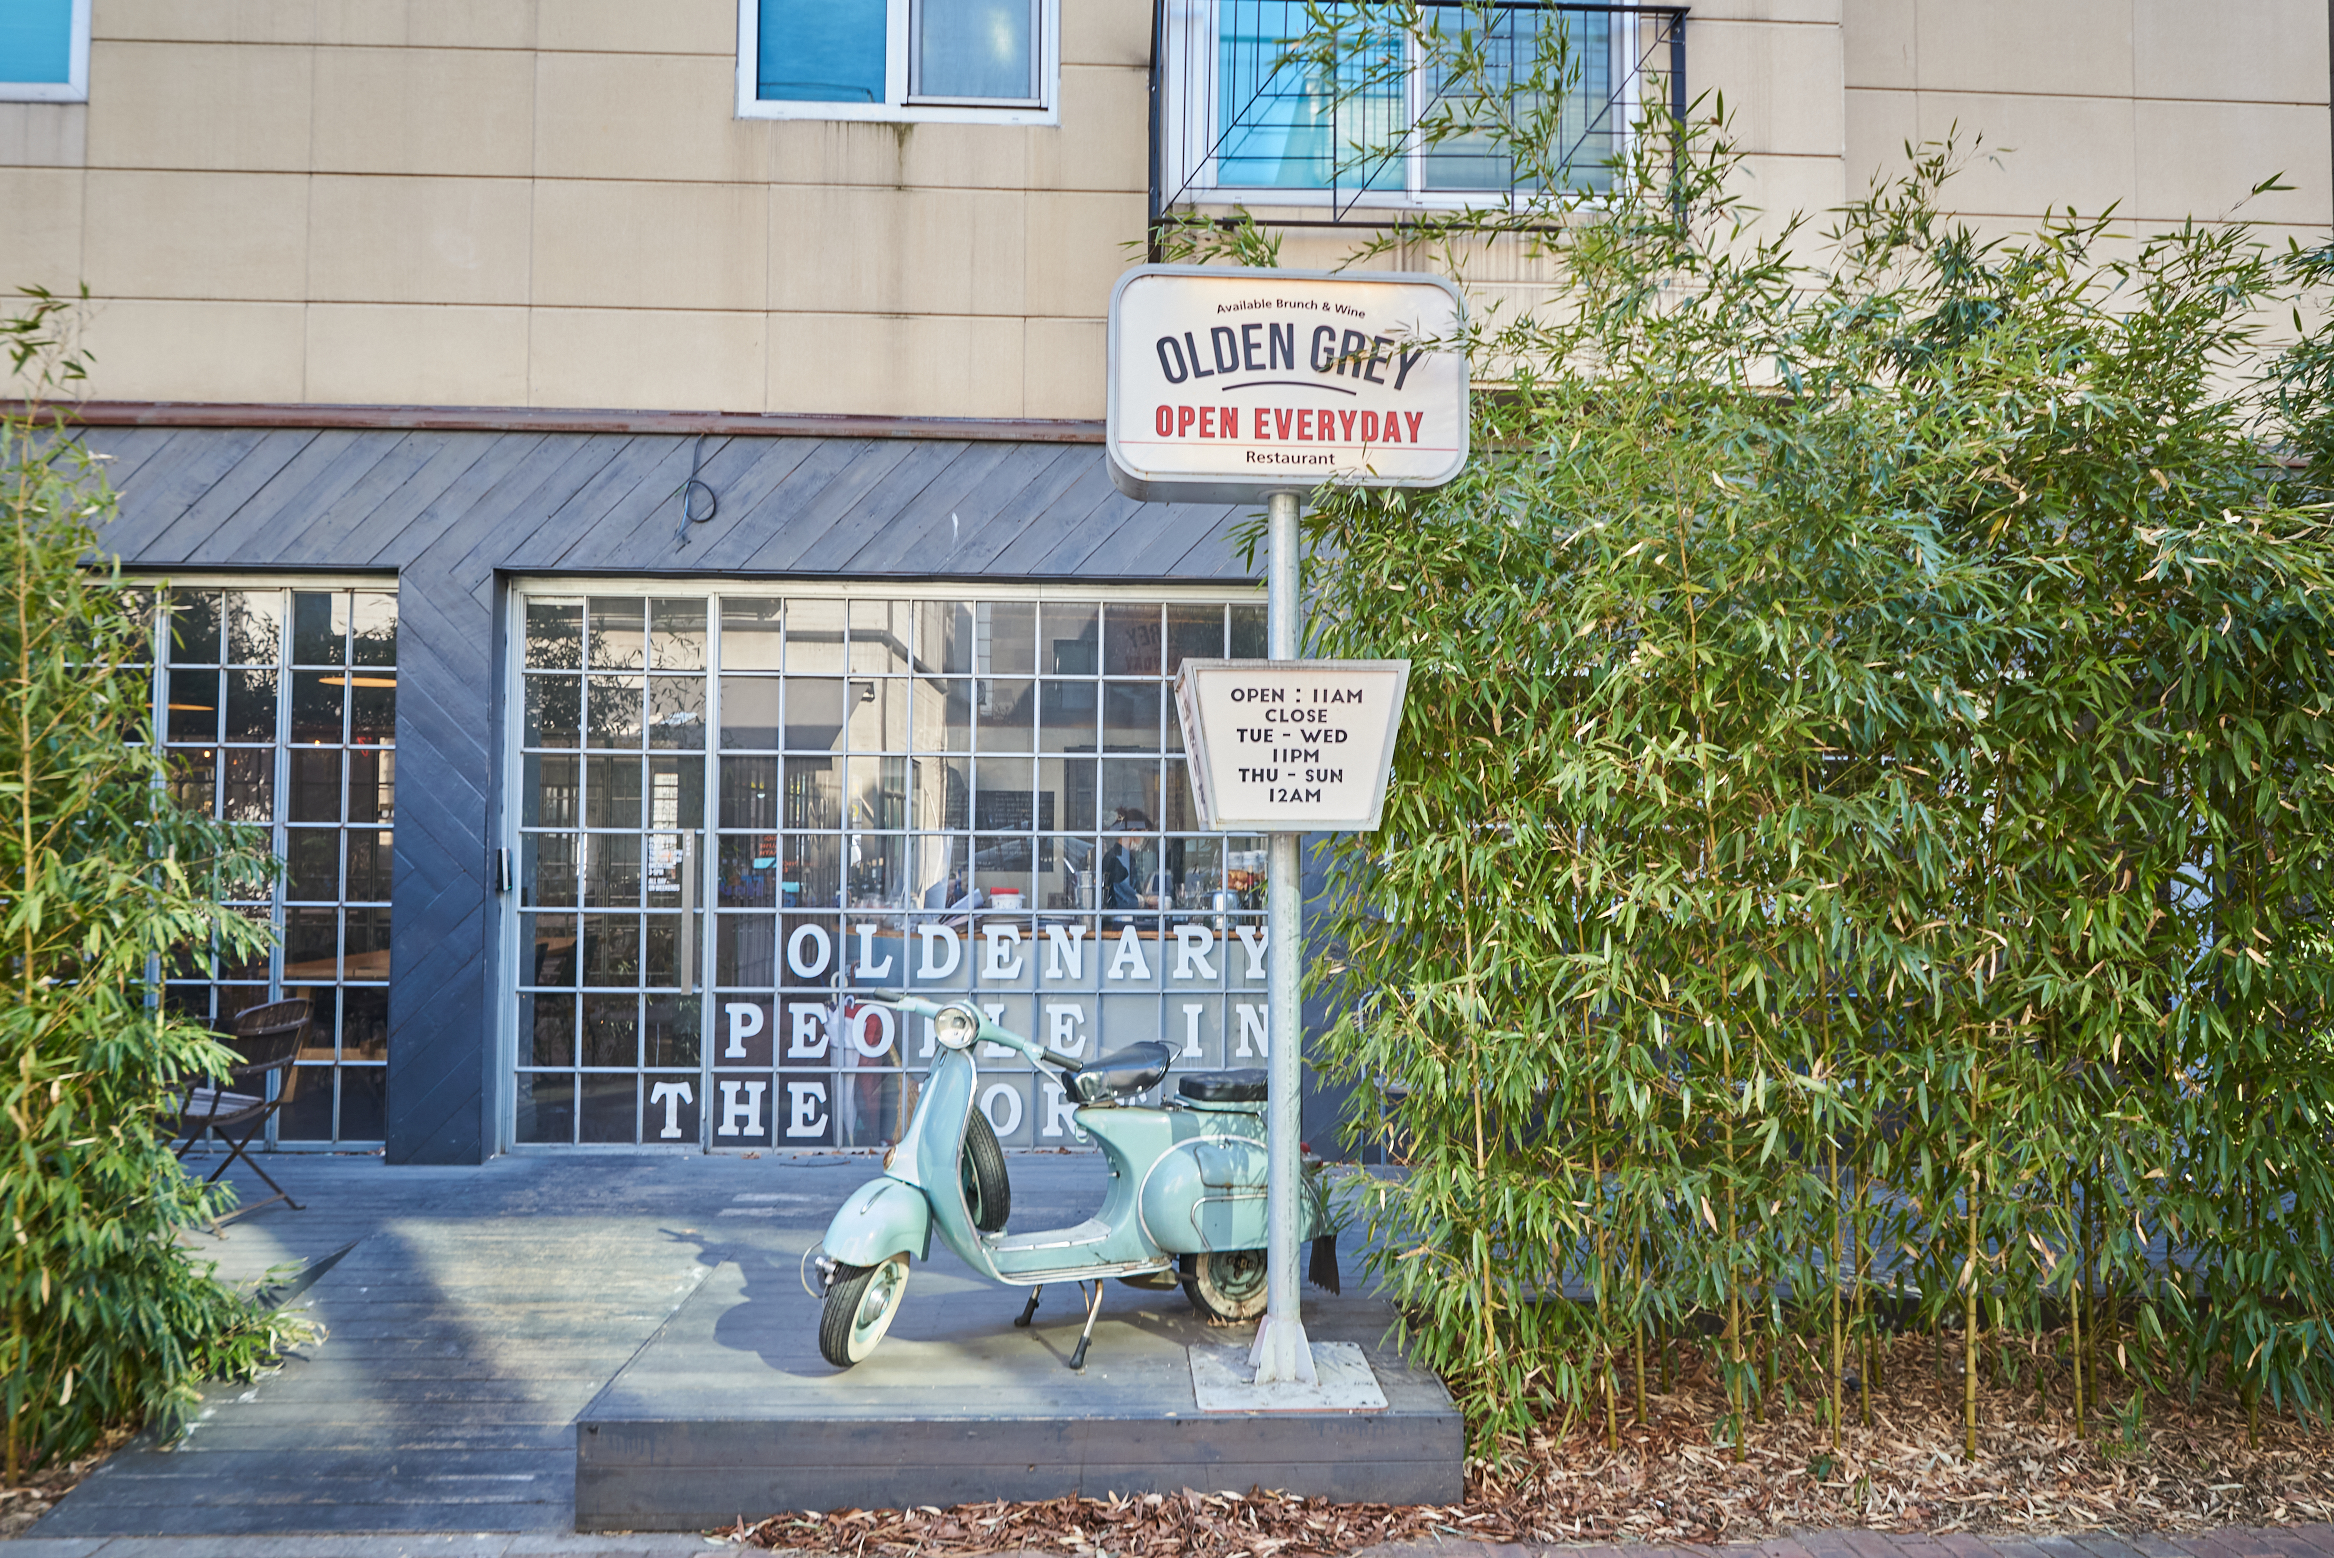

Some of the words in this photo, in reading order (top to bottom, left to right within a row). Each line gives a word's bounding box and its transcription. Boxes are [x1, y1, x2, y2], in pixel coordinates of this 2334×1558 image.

[1217, 299, 1272, 314] Available
[1276, 298, 1318, 310] Brunch
[1322, 302, 1331, 312] &
[1335, 303, 1366, 319] Wine
[1156, 323, 1295, 384] OLDEN
[1310, 325, 1425, 391] GREY
[1155, 405, 1239, 439] OPEN
[1254, 408, 1424, 443] EVERYDAY
[1246, 450, 1336, 466] Restaurant
[1230, 688, 1285, 702] OPEN
[1313, 688, 1363, 704] 11AM
[1265, 709, 1328, 723] CLOSE
[1236, 728, 1274, 743] TUE
[1300, 728, 1348, 743] WED
[1272, 748, 1319, 763] 11PM
[1238, 768, 1278, 783] THU
[1305, 768, 1343, 783] SUN
[1269, 788, 1321, 803] 12AM
[787, 923, 1269, 980] OLDENARY
[1182, 1004, 1269, 1058] IN
[650, 1080, 829, 1138] THE
